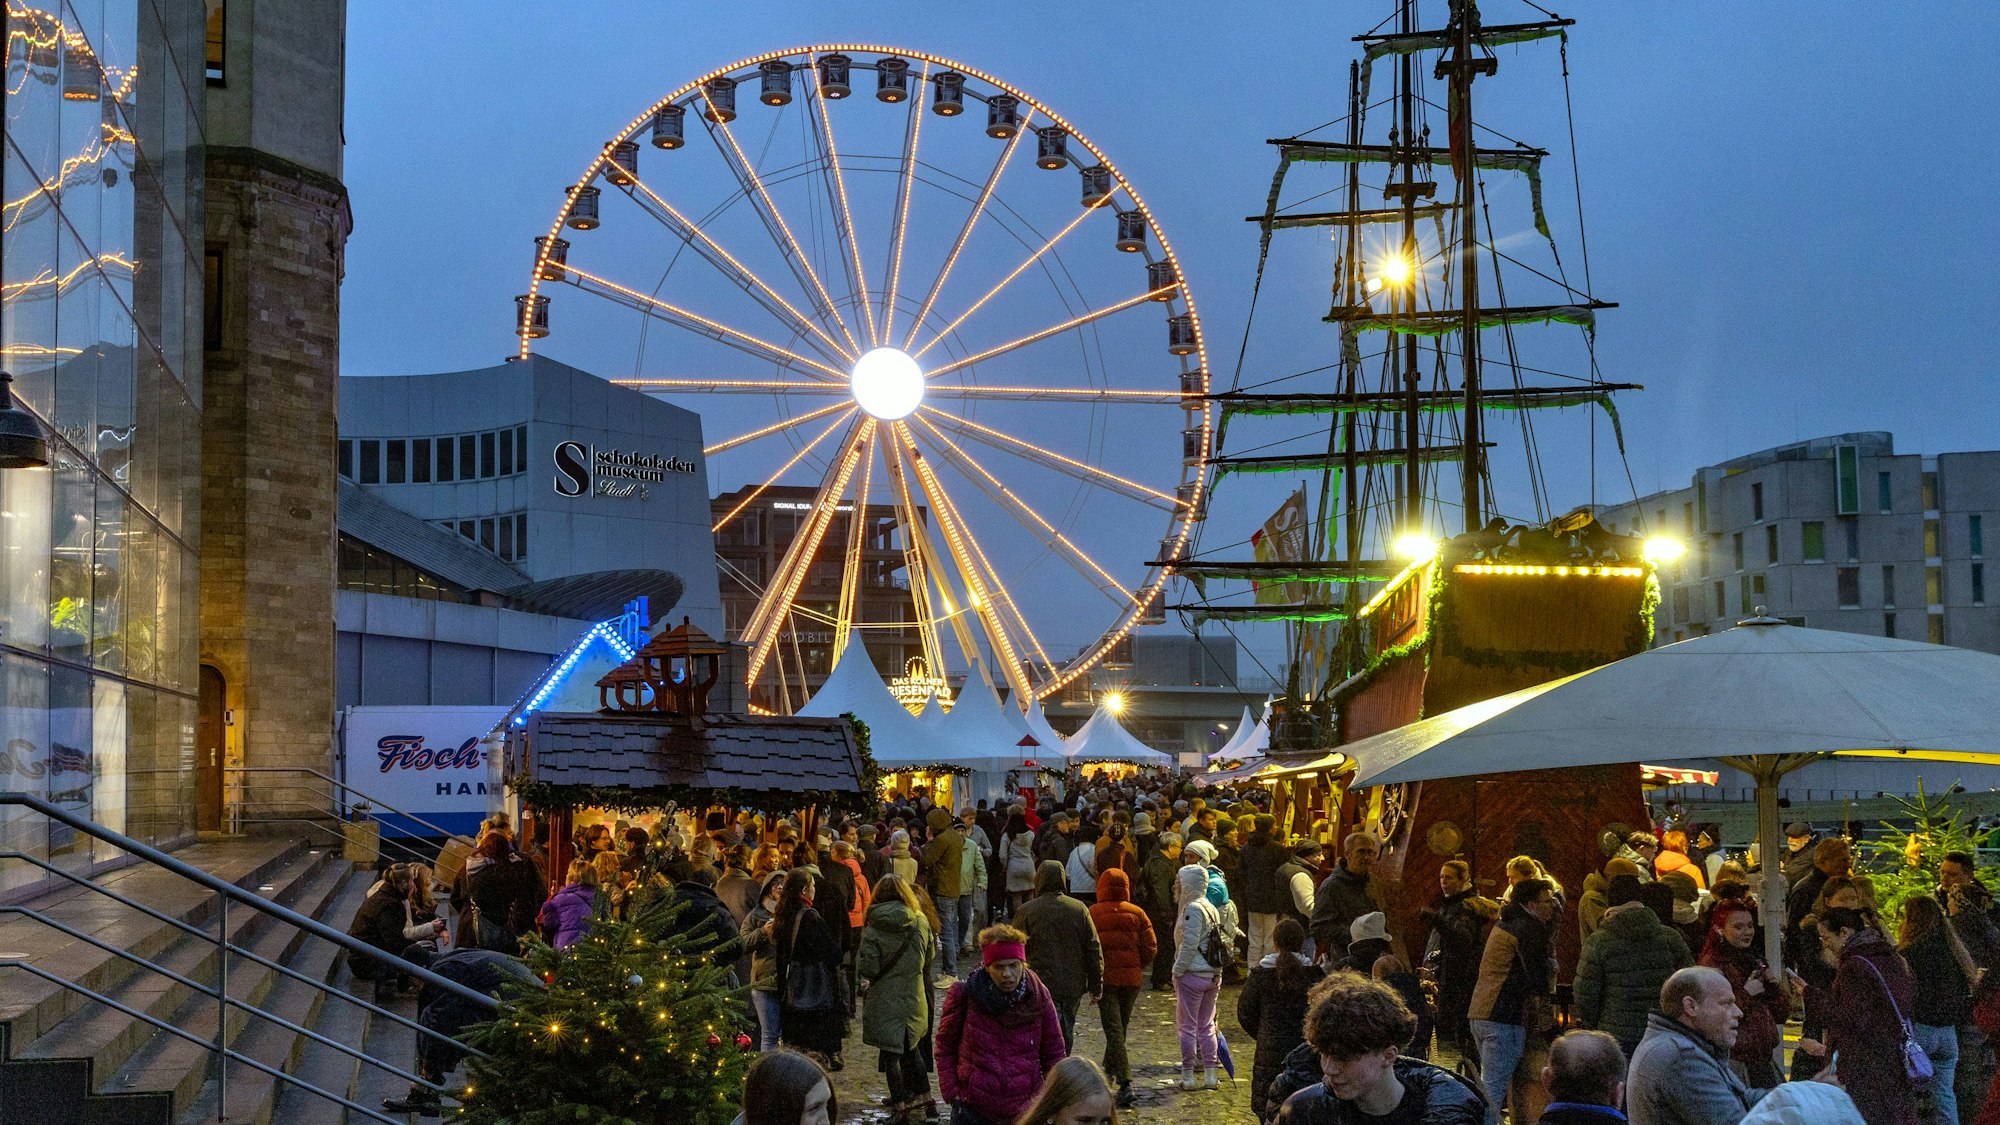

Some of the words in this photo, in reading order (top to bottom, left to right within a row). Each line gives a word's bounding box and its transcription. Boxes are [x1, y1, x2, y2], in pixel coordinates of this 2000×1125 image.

[553, 440, 590, 498] S
[595, 449, 696, 474] schokoladen
[595, 464, 664, 483] museum
[773, 502, 797, 510] SIGNAL
[892, 677, 909, 686] DAS
[887, 685, 952, 698] RIESENRAD
